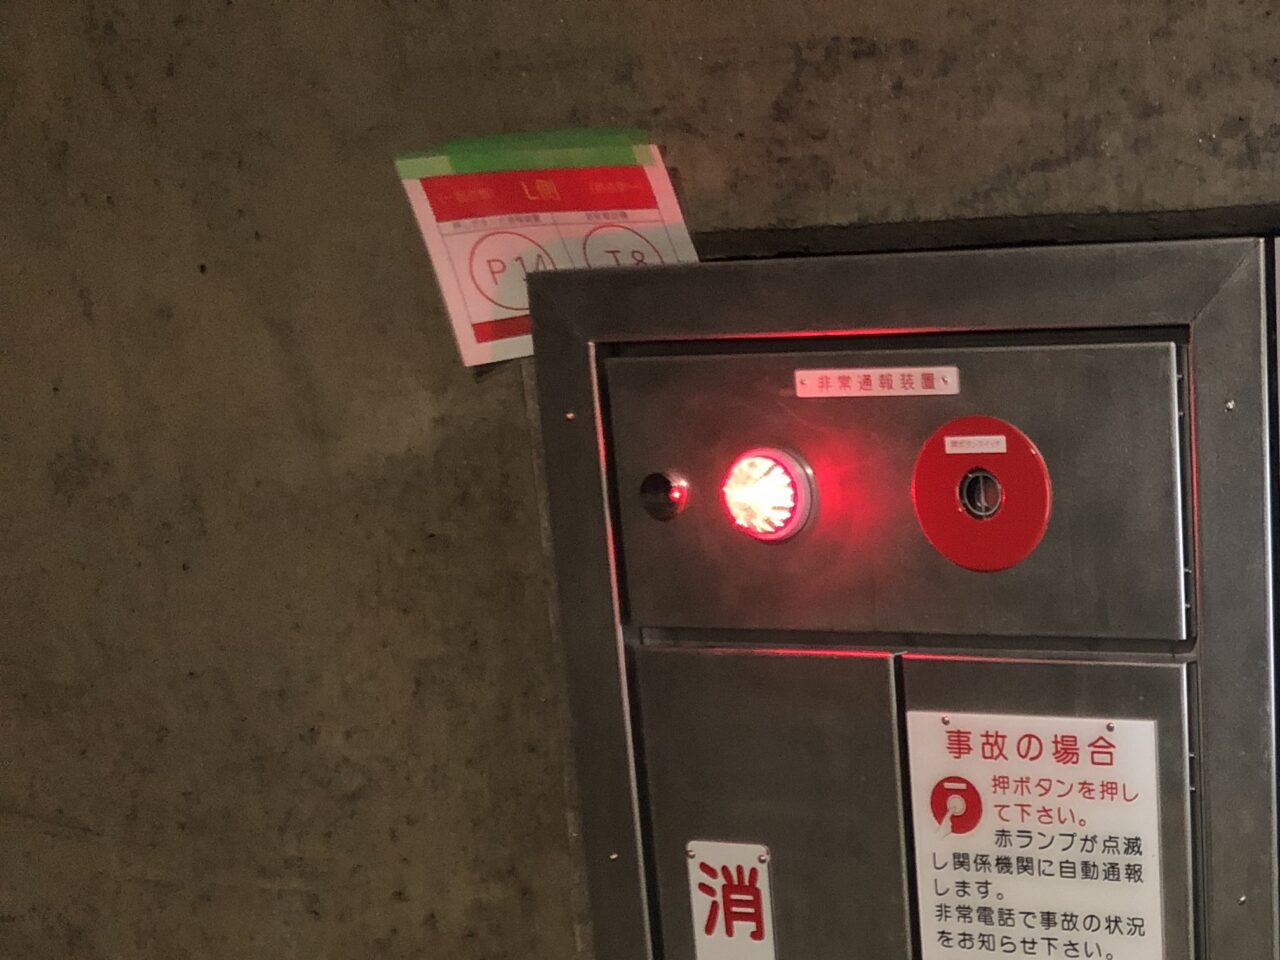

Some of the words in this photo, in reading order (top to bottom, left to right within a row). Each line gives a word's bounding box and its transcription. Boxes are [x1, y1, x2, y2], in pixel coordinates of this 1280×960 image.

[817, 372, 936, 392] 非常通報装置
[945, 729, 1117, 767] 事故の場合
[991, 774, 1140, 803] 押ボタンを押し
[993, 802, 1088, 828] て下さい。
[994, 828, 1144, 858] 赤ランプが点滅
[932, 850, 1145, 885] し関係機関に自動通報
[933, 878, 1005, 902] します。
[935, 903, 1147, 938] 非常電話で事故の状況
